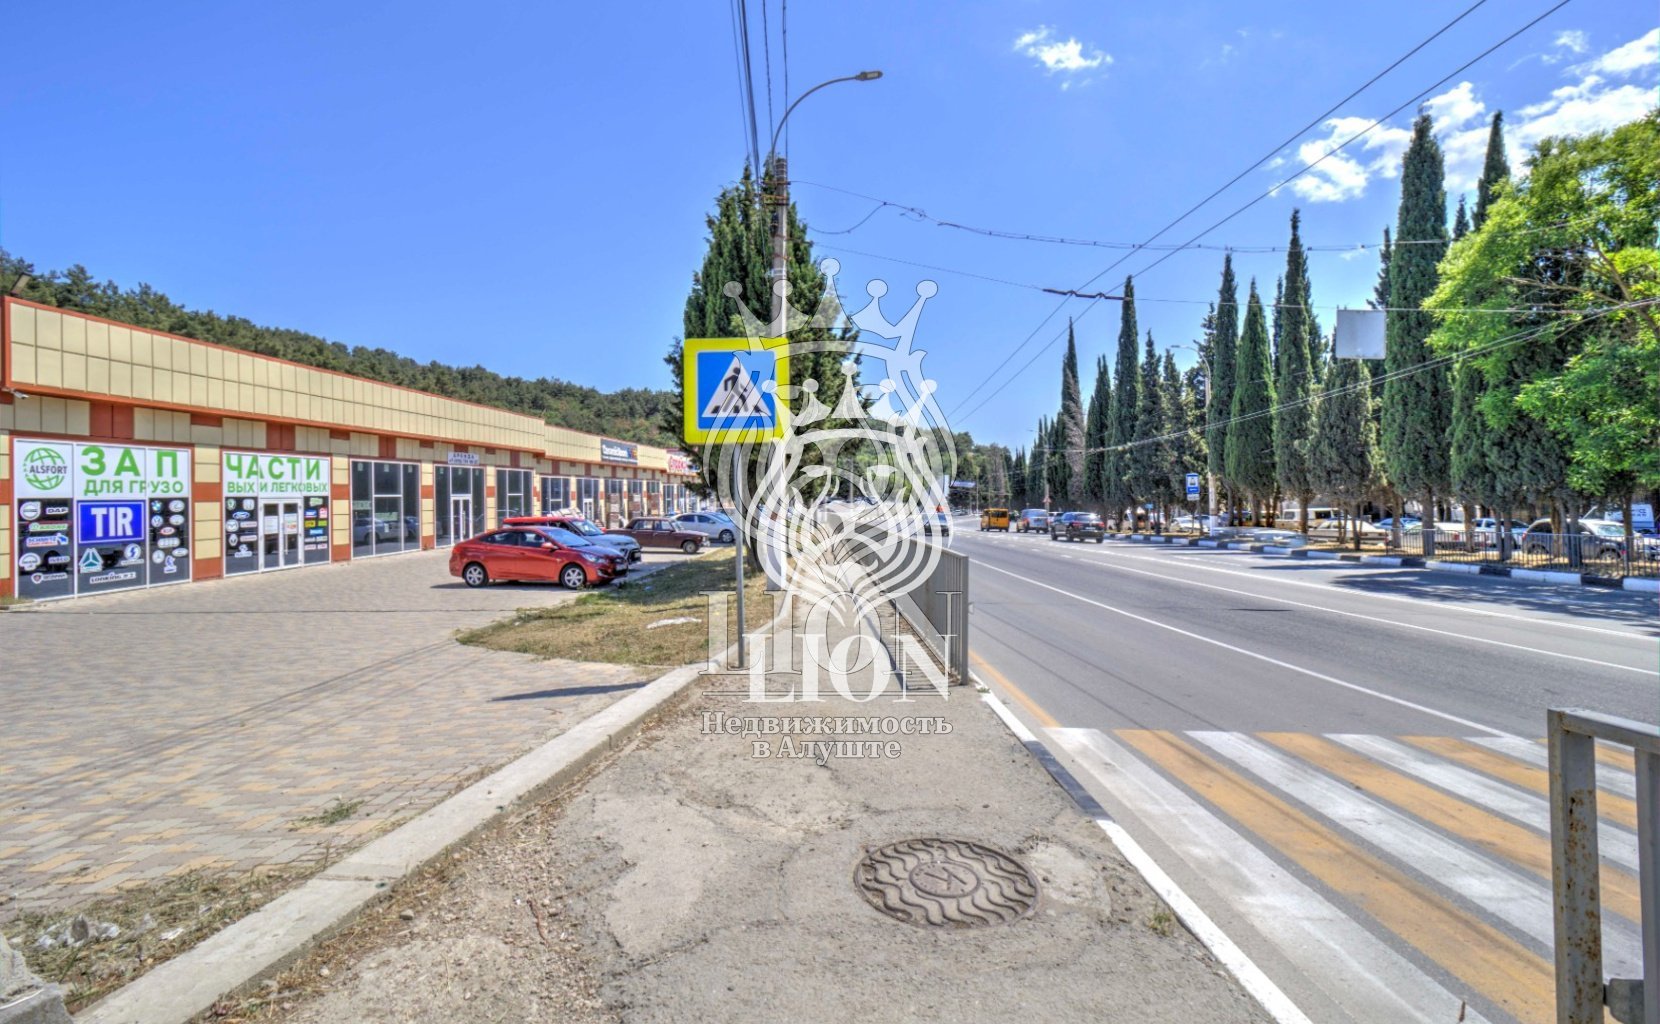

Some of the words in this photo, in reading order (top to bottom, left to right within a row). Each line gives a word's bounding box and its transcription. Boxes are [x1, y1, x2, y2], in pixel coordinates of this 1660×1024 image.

[29, 464, 68, 475] ALSFORT
[81, 445, 178, 477] ЗАП
[225, 453, 321, 481] ЧАСТИ
[84, 480, 123, 496] ДЛЯ
[129, 480, 184, 494] ГРУЗО
[227, 482, 255, 493] ВЫХ
[259, 482, 268, 493] И
[271, 482, 328, 493] ЛЕГКОВЫХ
[91, 506, 133, 538] TIR
